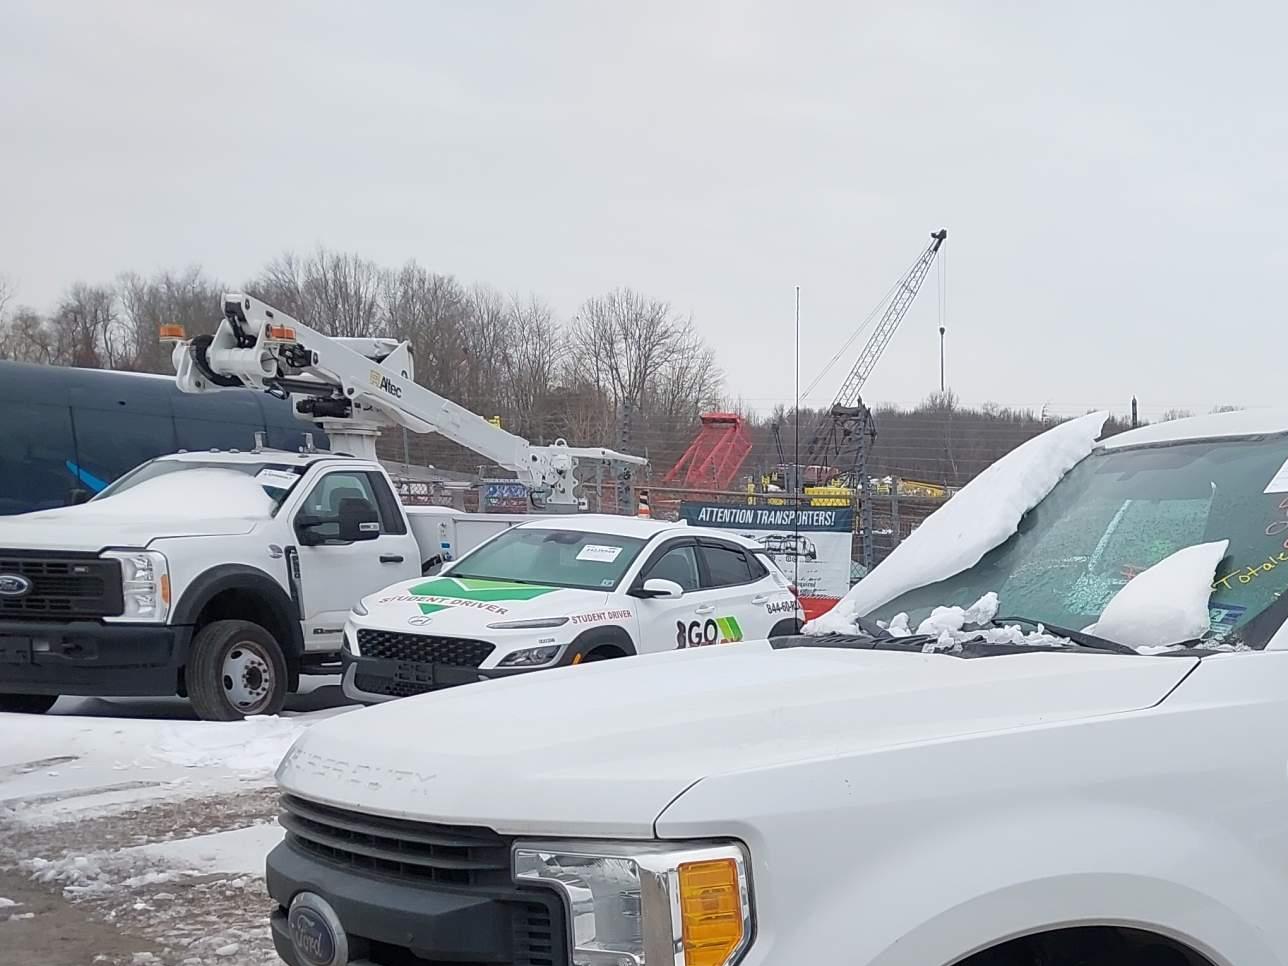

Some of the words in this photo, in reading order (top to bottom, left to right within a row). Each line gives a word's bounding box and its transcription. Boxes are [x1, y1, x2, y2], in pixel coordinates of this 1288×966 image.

[380, 376, 402, 398] Altec
[698, 507, 754, 523] ATTENTION
[757, 510, 836, 526] TRANSPORTERS!
[379, 595, 447, 603] STUDENT
[451, 599, 509, 615] DRIVER
[571, 612, 606, 624] STUDENT
[608, 609, 632, 619] DRIVER
[295, 914, 323, 956] Ford
